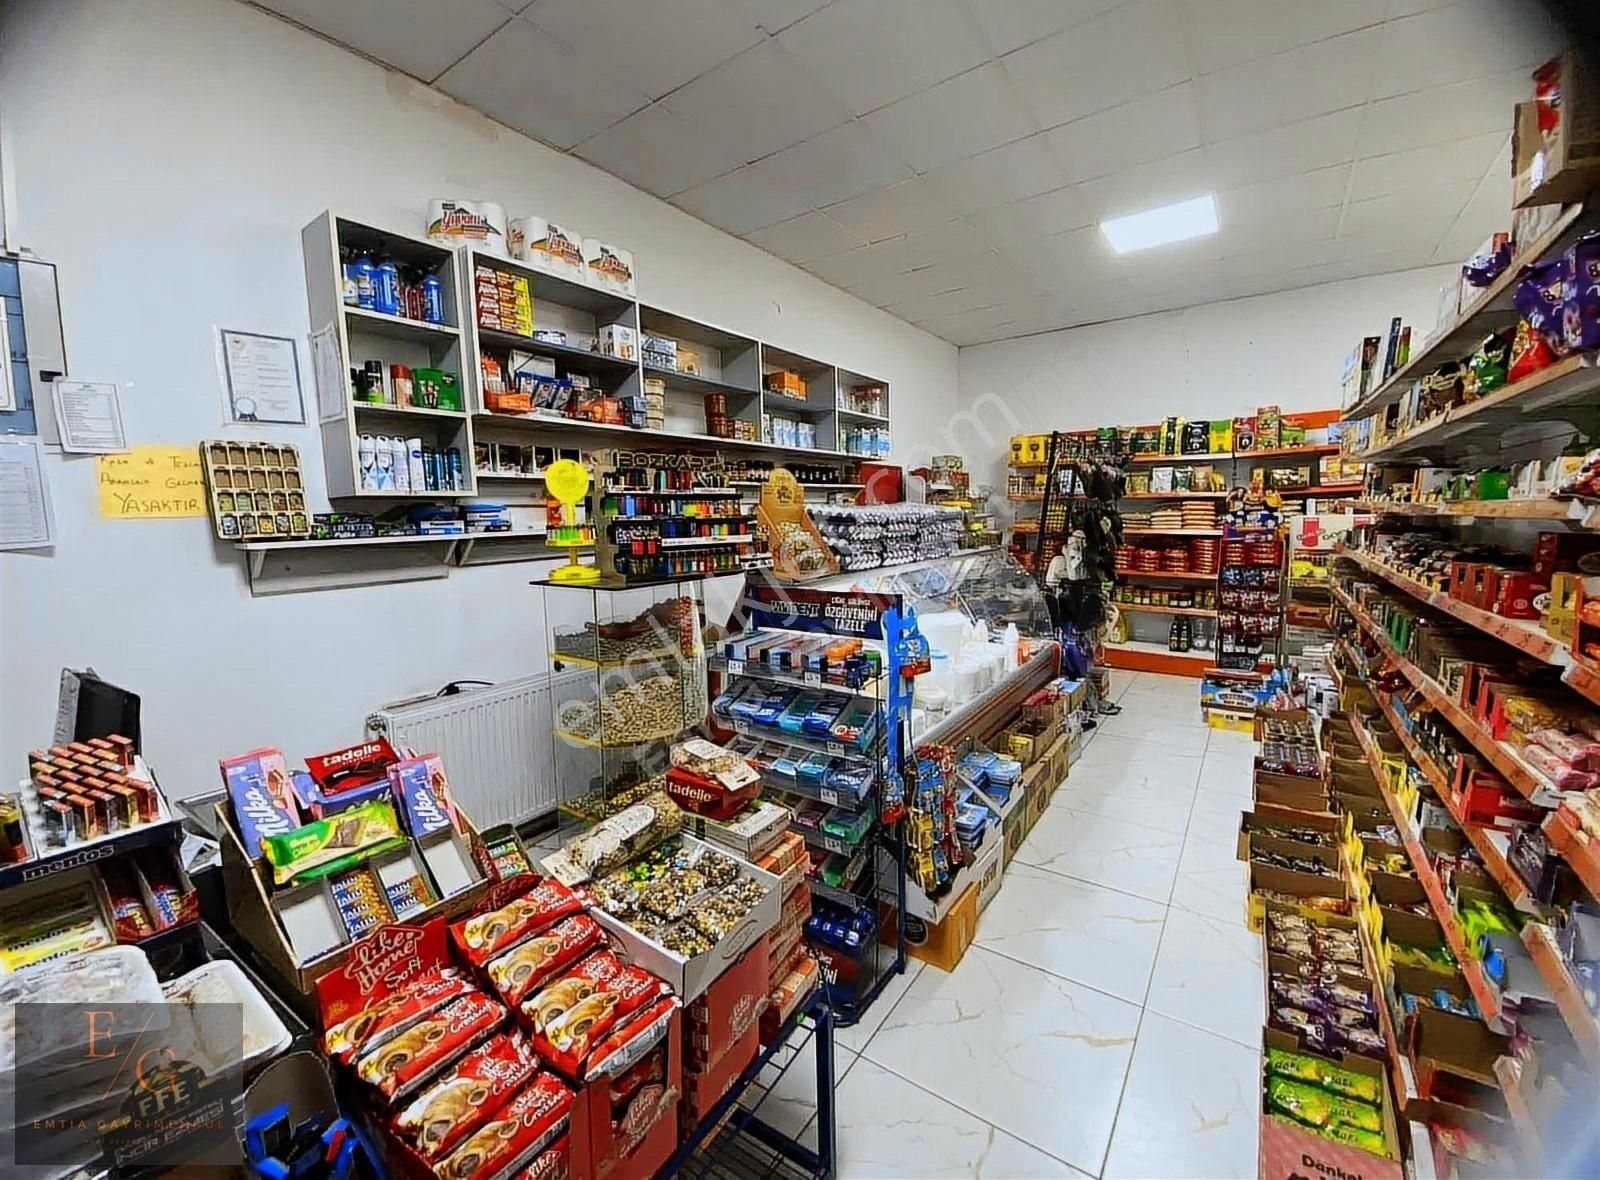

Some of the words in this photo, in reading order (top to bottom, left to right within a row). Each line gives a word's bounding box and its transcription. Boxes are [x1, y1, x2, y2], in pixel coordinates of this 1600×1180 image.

[113, 492, 201, 515] YASAKTIR
[835, 618, 867, 632] TAZELE
[668, 779, 712, 803] tadelle
[242, 787, 290, 837] Milka
[24, 844, 114, 881] mentos
